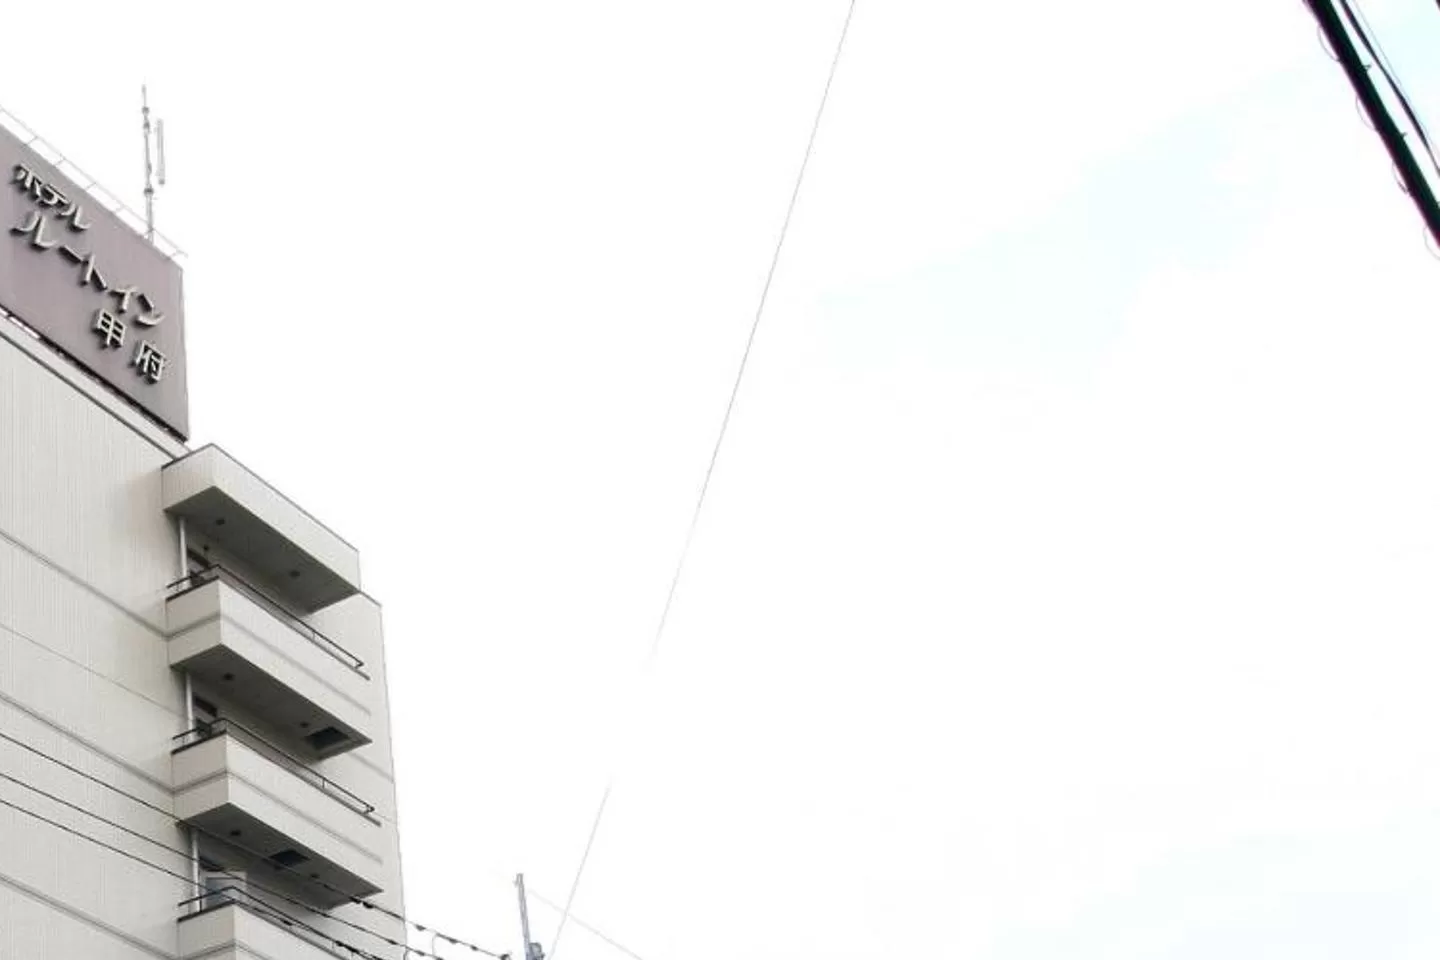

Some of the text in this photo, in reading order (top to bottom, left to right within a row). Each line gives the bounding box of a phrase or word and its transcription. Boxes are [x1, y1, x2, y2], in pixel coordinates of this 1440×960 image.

[10, 163, 92, 231] ホテル
[92, 308, 166, 385] 甲府
